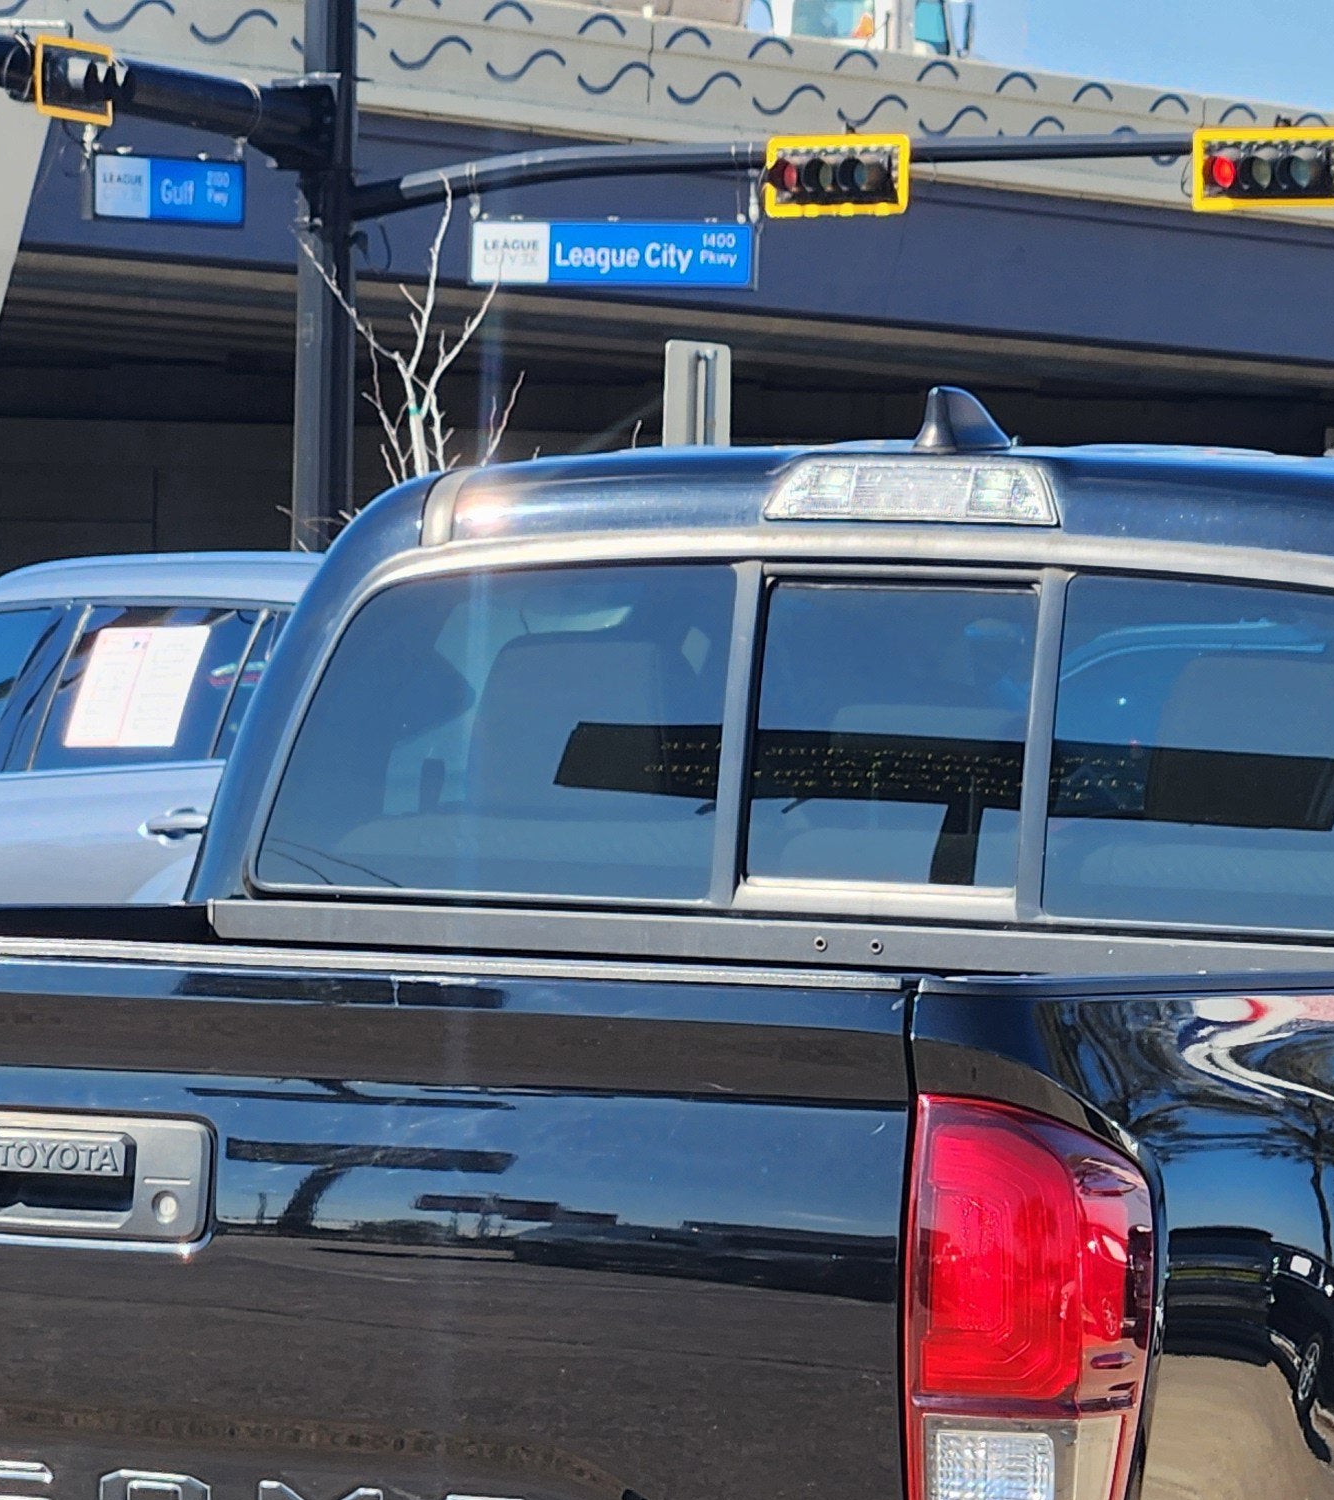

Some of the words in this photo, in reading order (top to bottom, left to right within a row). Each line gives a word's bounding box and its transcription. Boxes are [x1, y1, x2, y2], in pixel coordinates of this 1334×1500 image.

[483, 238, 540, 252] LEAGUE
[701, 232, 736, 248] 1400
[555, 241, 640, 275] League
[644, 242, 694, 275] City
[699, 250, 738, 268] Pkwy
